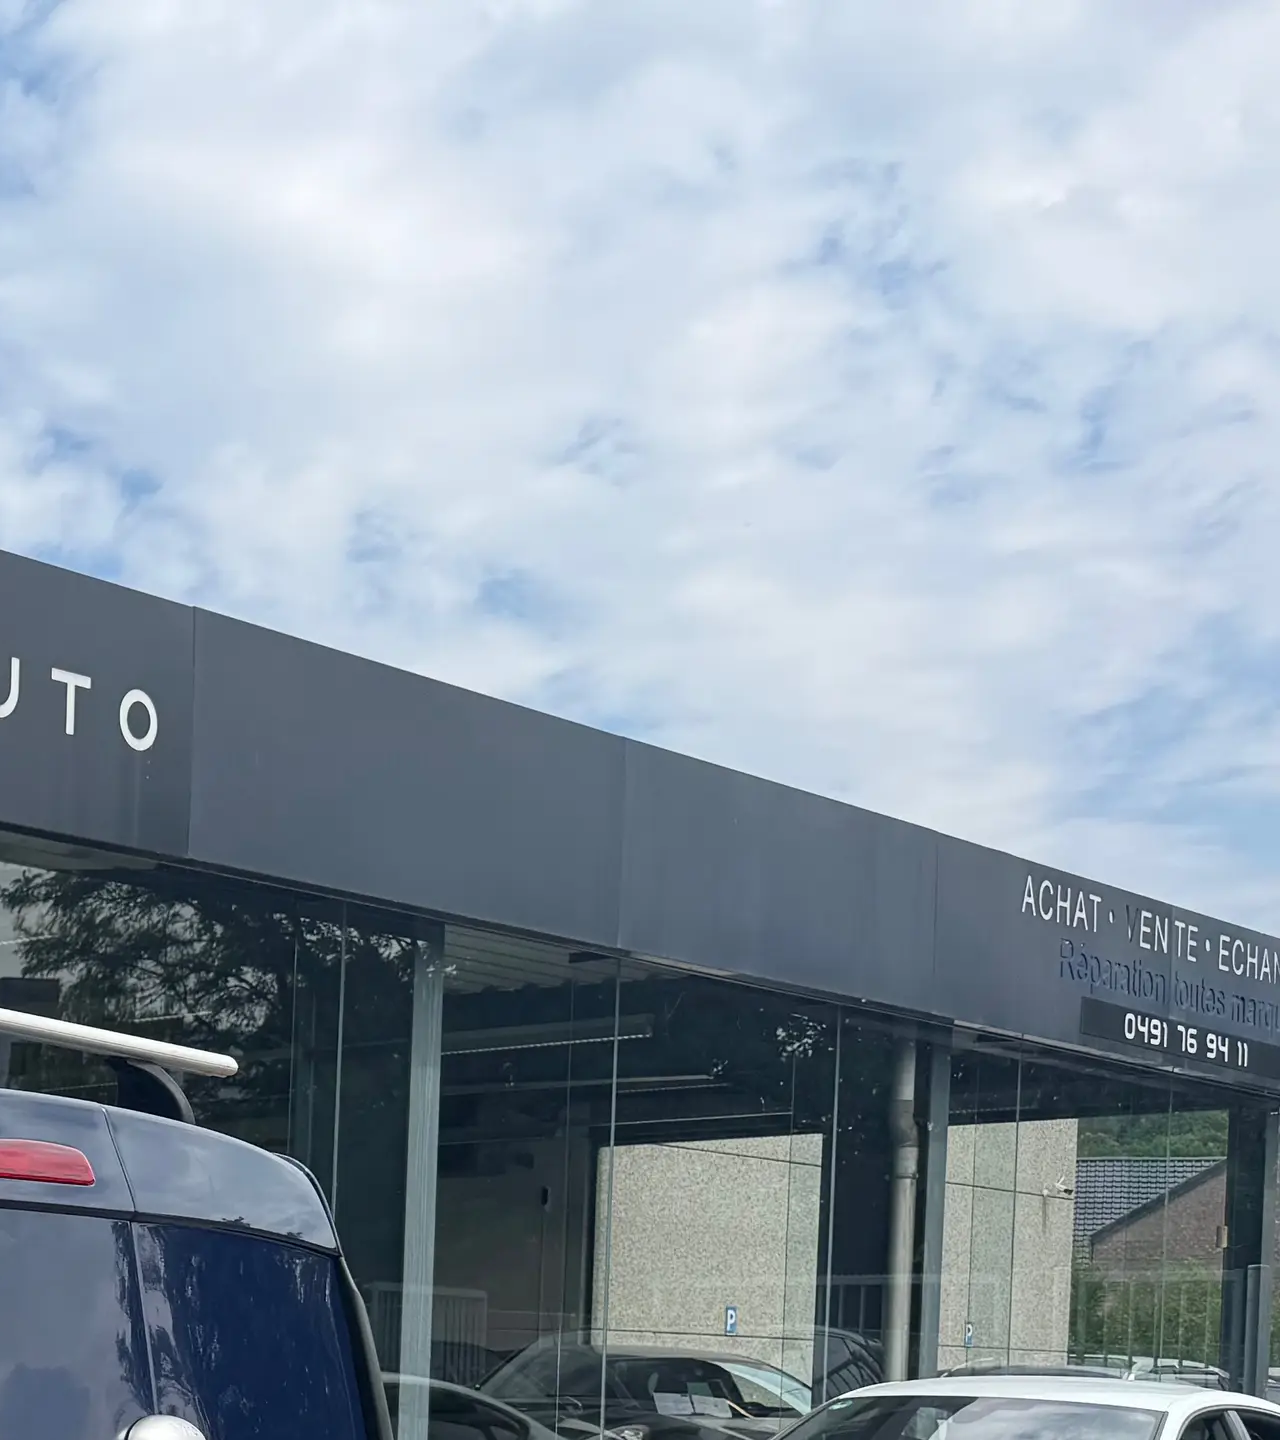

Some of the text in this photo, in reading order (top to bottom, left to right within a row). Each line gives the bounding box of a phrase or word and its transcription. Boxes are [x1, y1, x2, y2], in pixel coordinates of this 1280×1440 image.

[1021, 875, 1102, 932] ACHAT
[1125, 904, 1199, 963] VENTE
[1124, 1013, 1249, 1067] 0491 76 94 11
[726, 1309, 736, 1330] P
[965, 1323, 973, 1341] P
